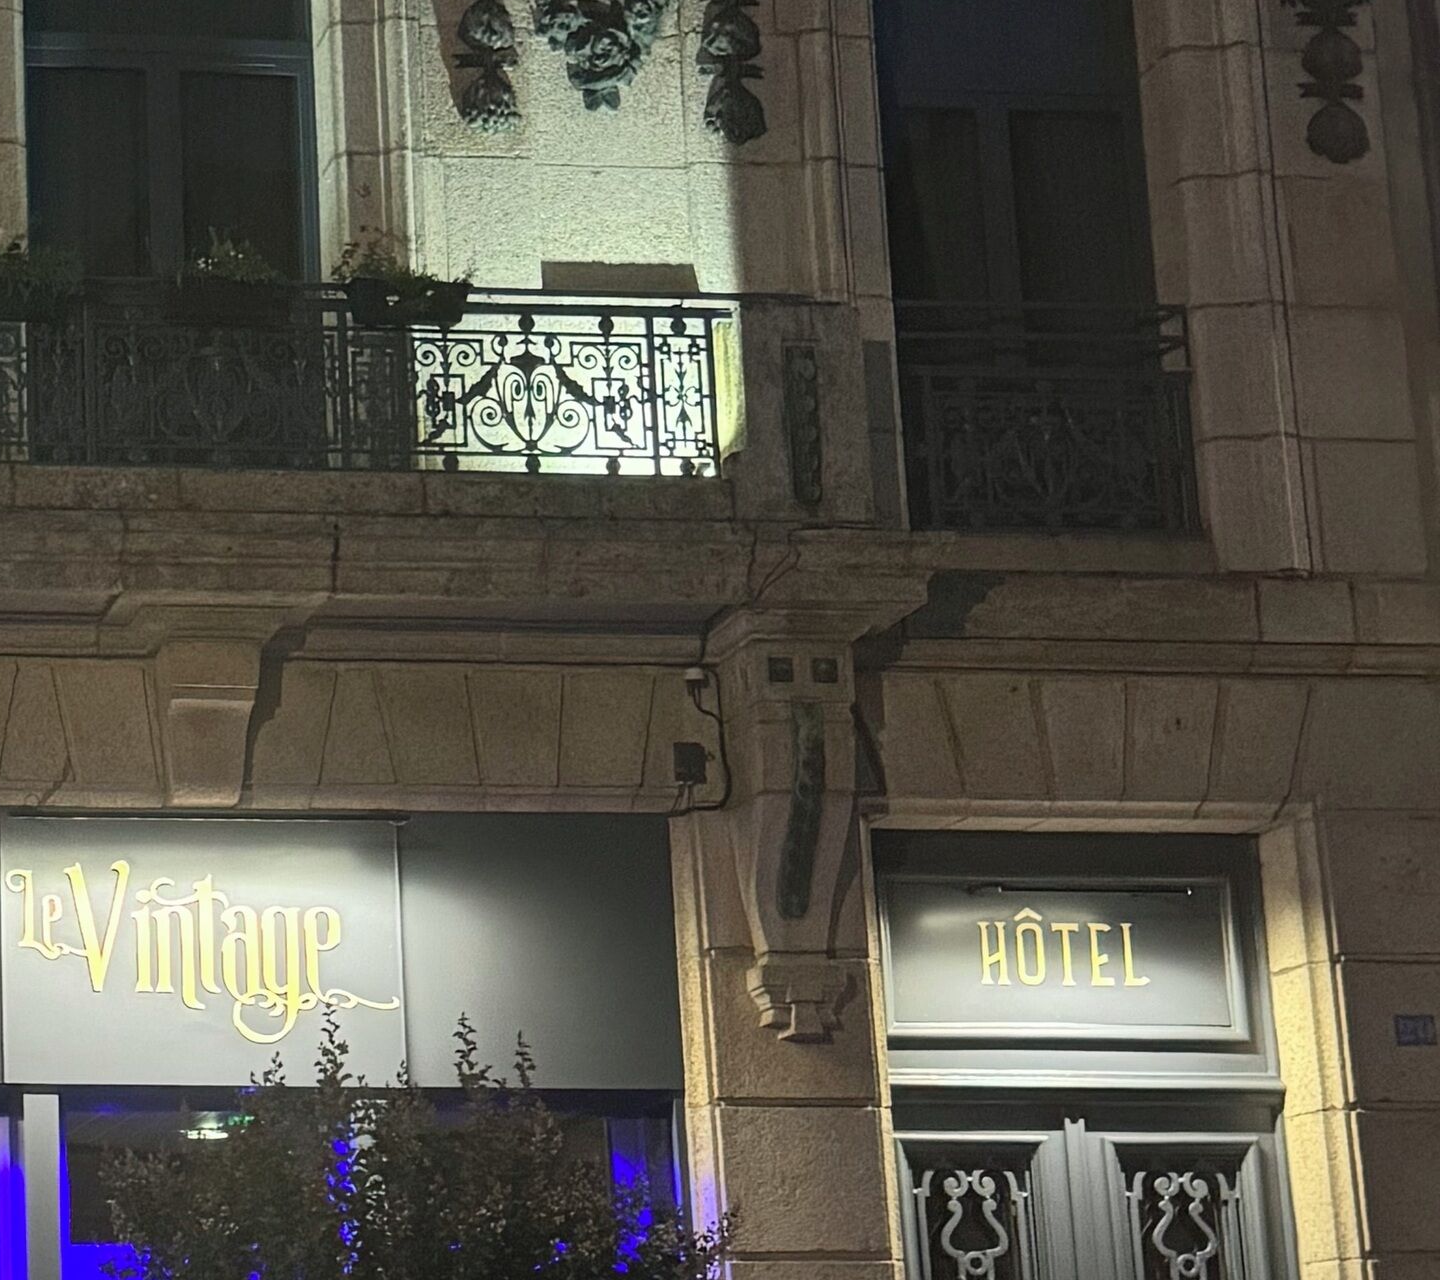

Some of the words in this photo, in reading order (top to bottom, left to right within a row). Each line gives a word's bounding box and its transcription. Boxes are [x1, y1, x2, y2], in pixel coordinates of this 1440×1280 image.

[5, 868, 68, 960] Le
[63, 859, 400, 1044] Vintage
[976, 907, 1152, 987] HÔTEL
